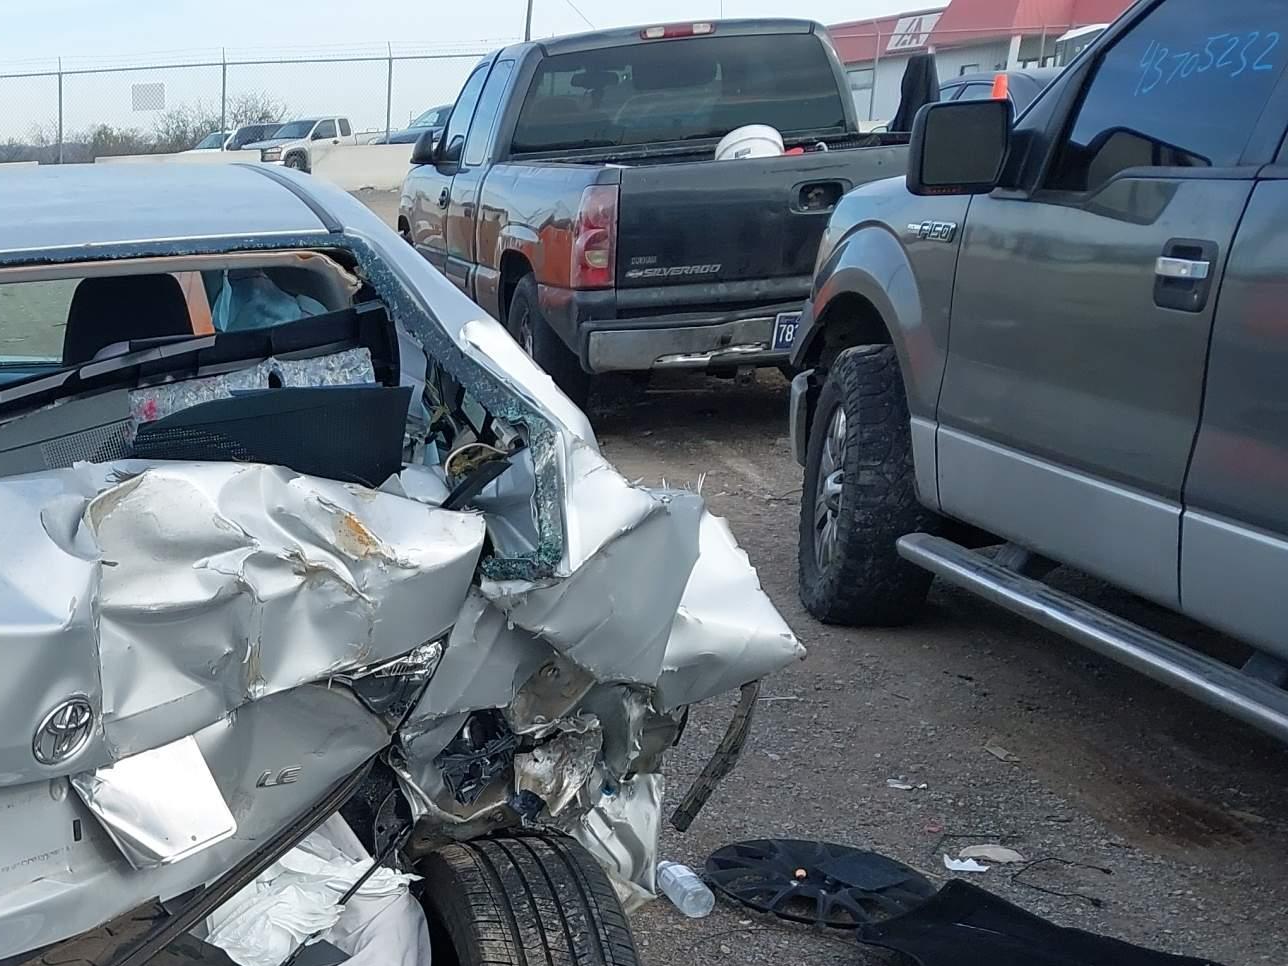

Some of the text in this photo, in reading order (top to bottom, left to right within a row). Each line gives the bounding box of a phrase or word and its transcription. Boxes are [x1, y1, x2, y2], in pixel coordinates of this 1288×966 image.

[1134, 31, 1280, 96] 43705232
[643, 263, 722, 278] SILVERADO
[255, 766, 303, 788] LE
